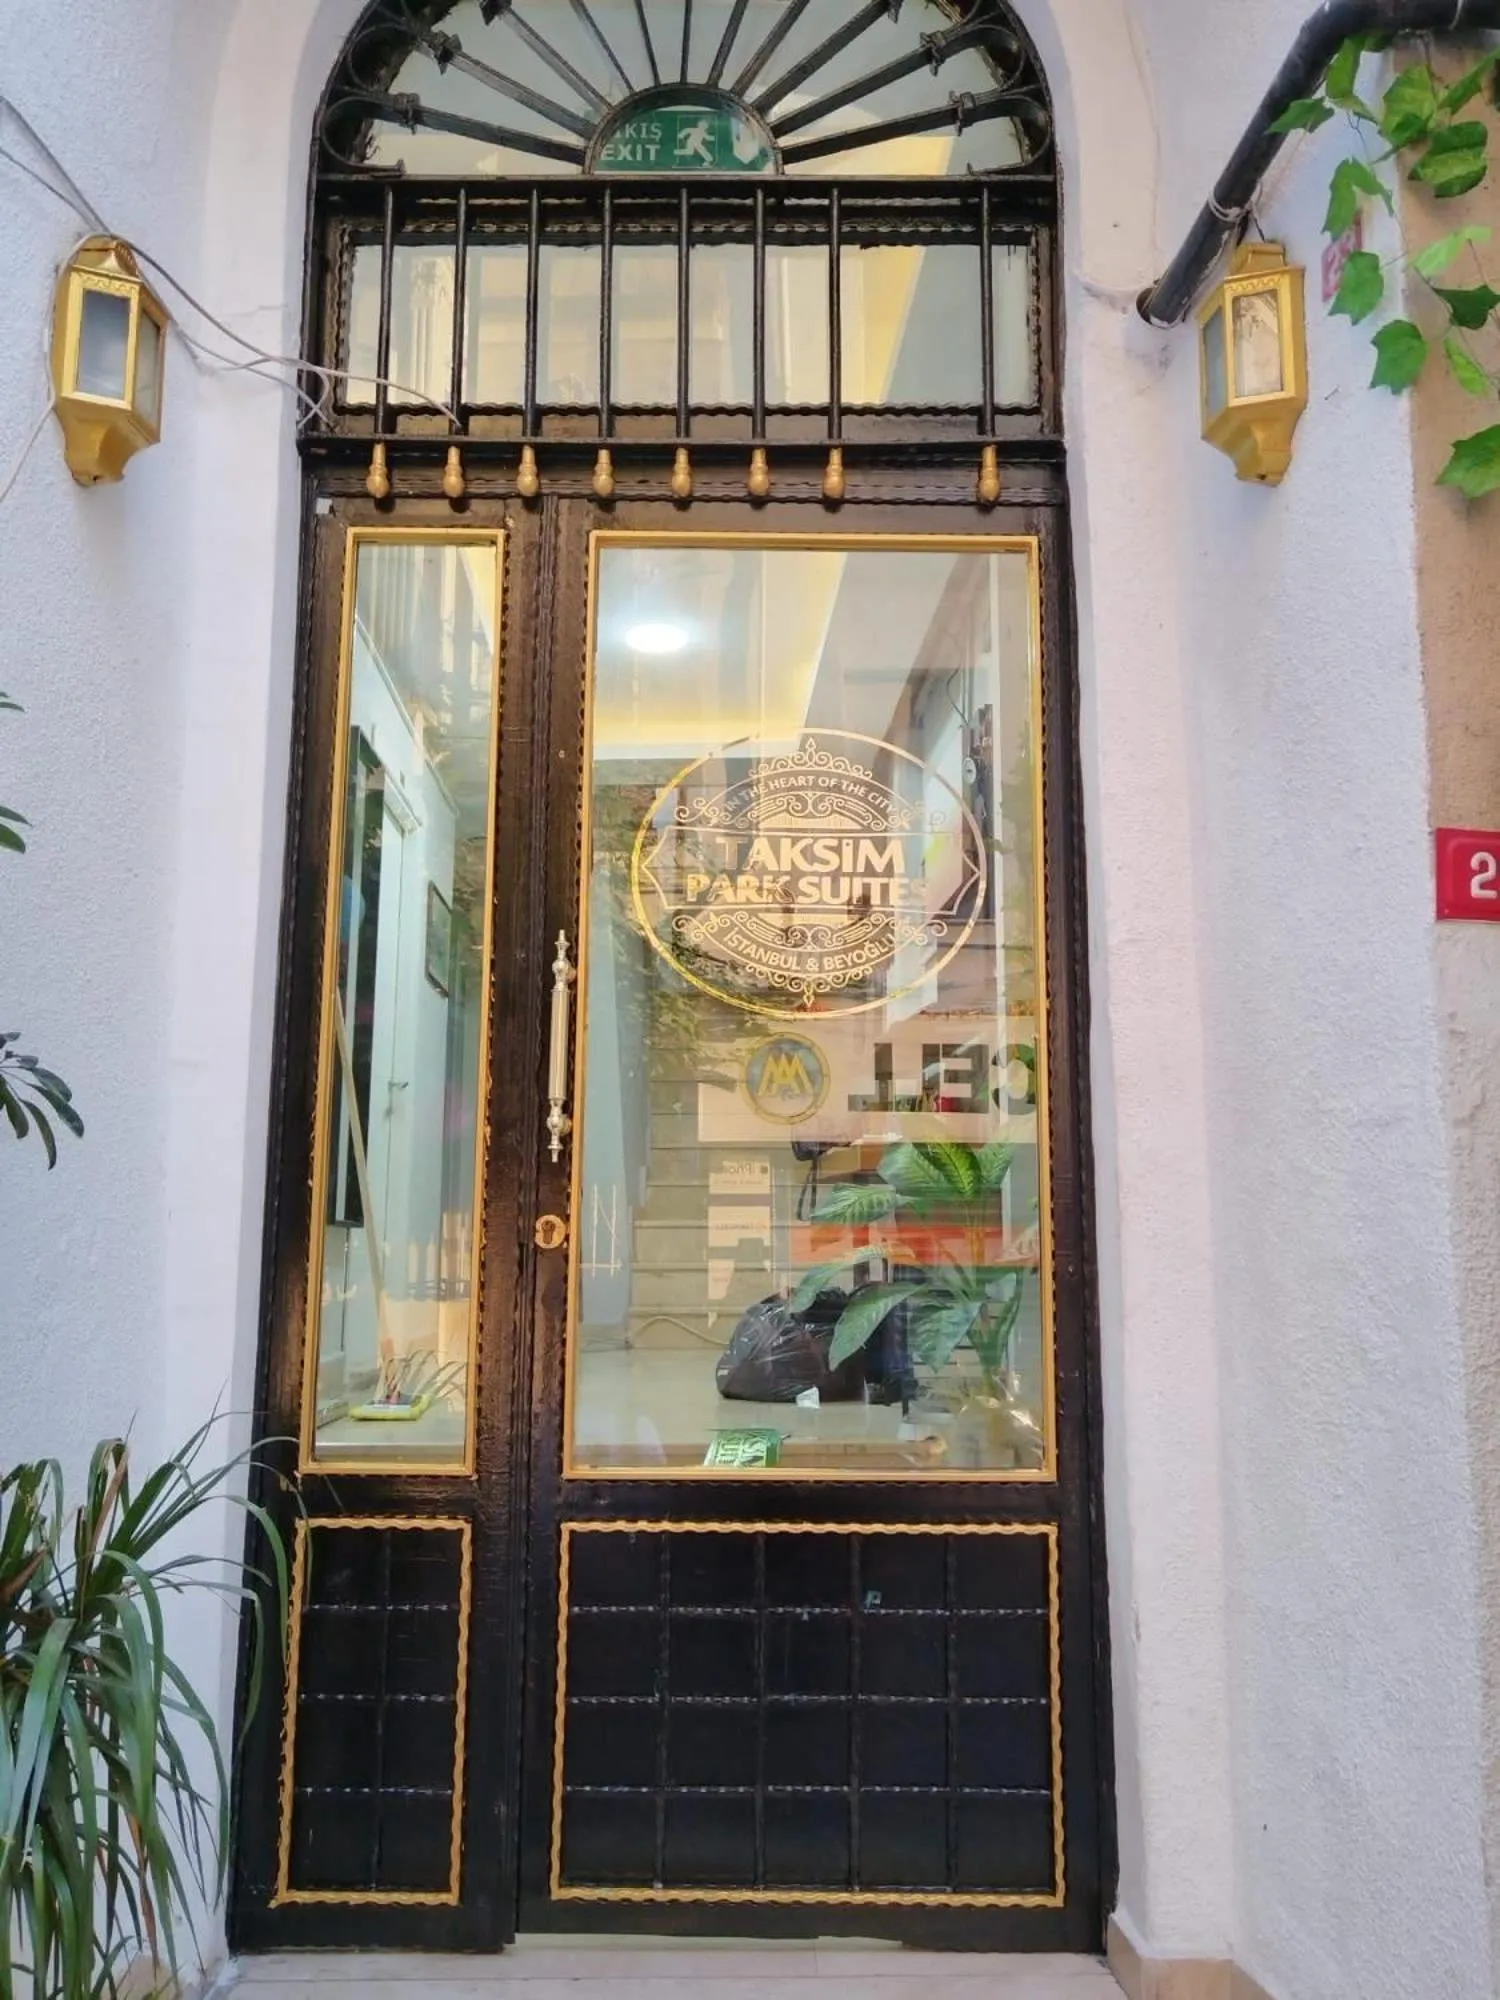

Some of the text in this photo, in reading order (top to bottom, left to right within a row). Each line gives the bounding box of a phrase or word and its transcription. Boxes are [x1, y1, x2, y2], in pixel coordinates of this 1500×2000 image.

[601, 144, 661, 161] EXIT
[724, 775, 896, 814] IN THE HEART OF THE CITY
[686, 873, 928, 906] PARK SUITES
[1470, 851, 1498, 899] 2
[723, 927, 897, 972] İSTANBUL & BEYOĞLU
